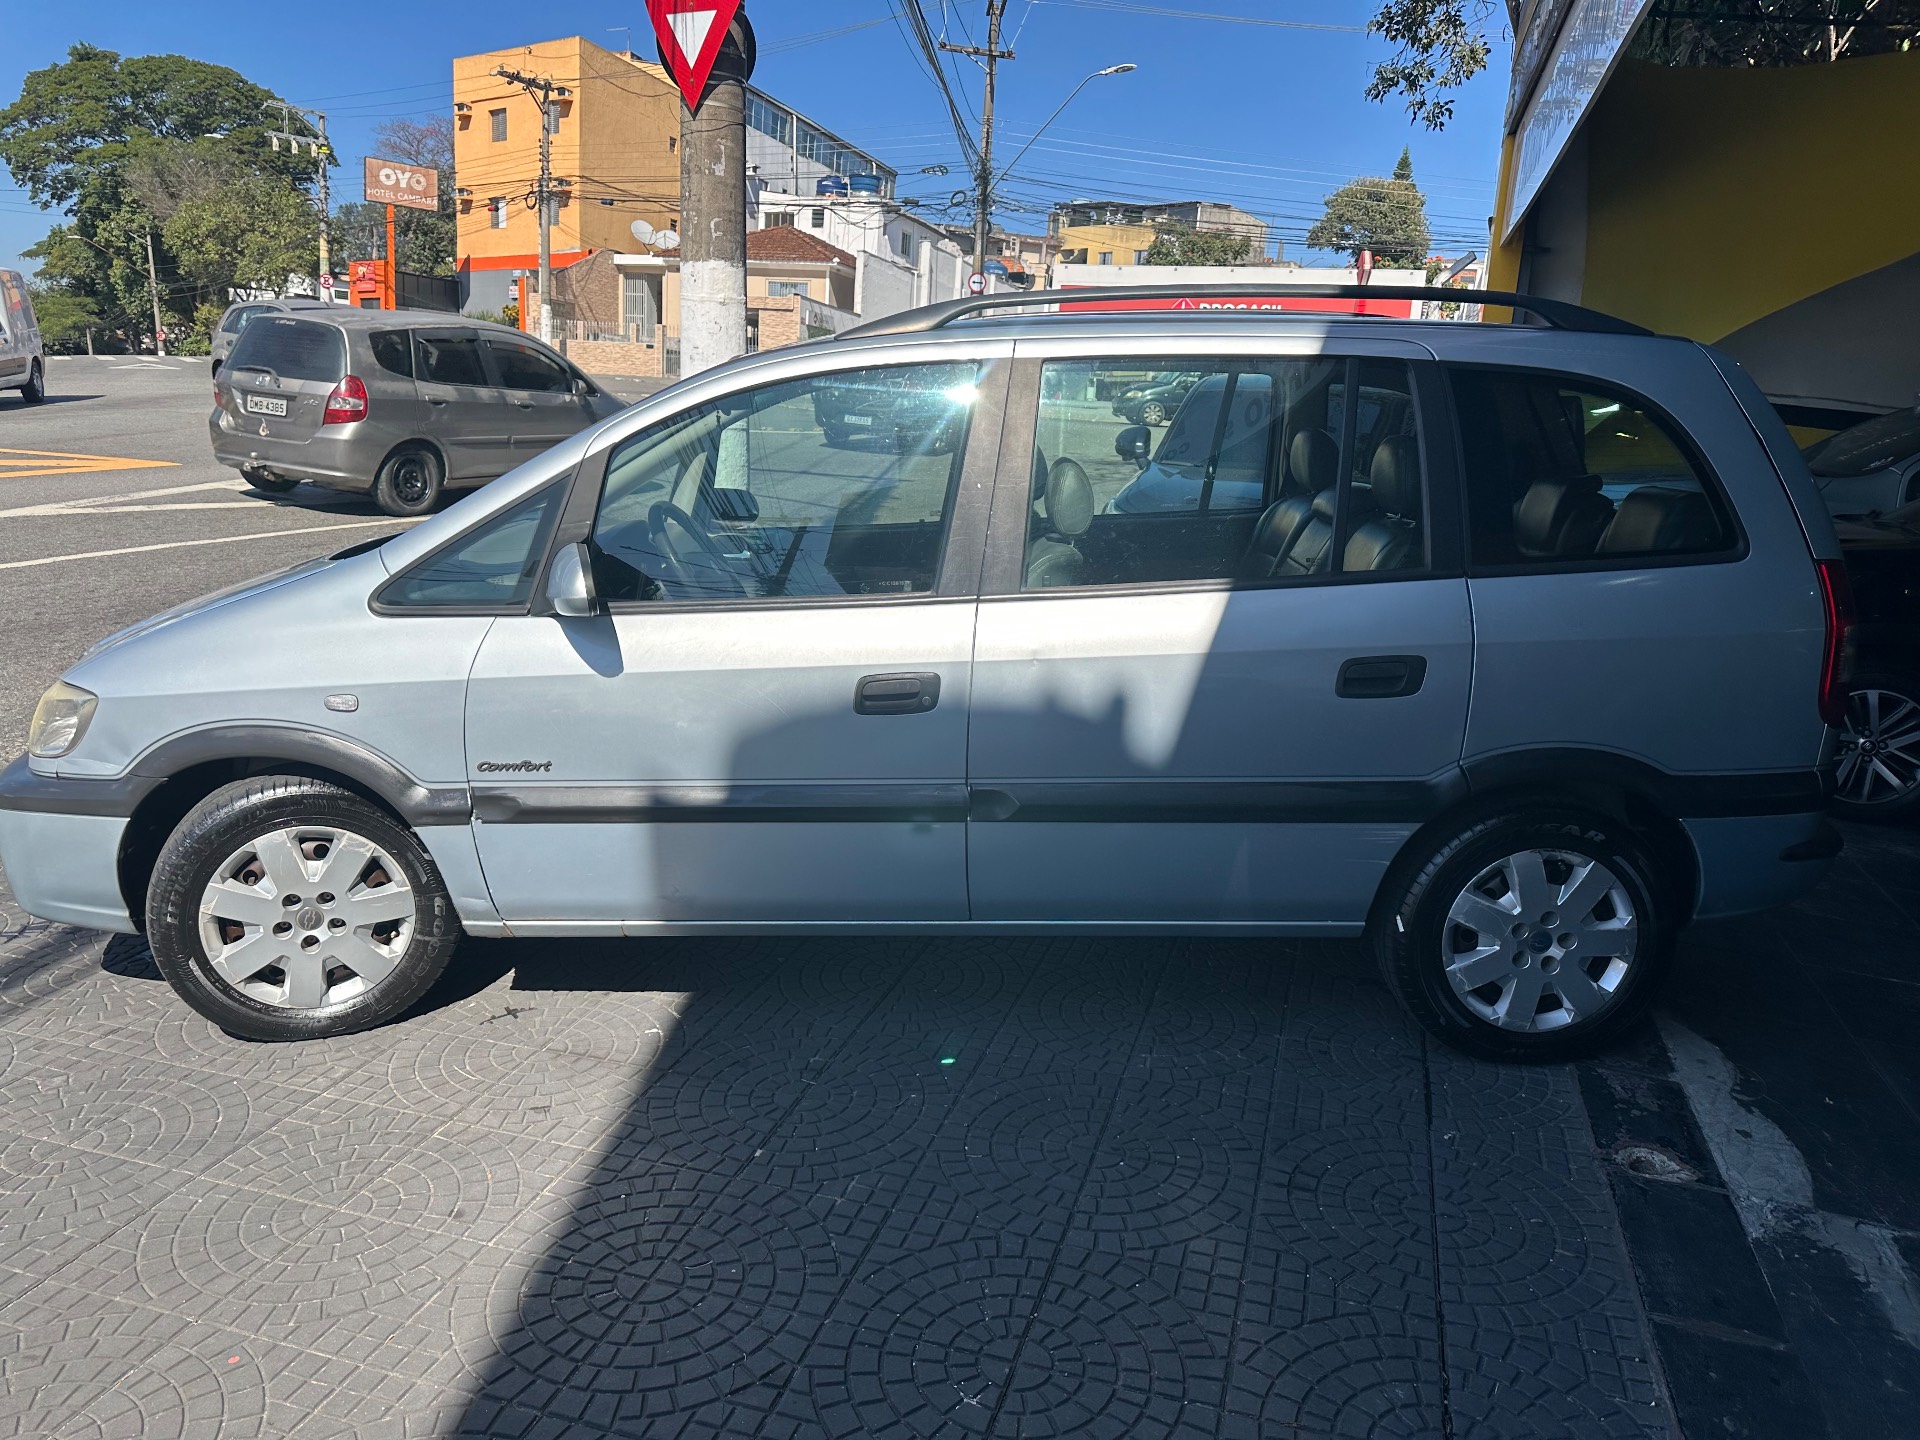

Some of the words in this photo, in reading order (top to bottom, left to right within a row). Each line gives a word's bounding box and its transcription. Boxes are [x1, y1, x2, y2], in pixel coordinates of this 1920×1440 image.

[379, 167, 427, 191] OYO
[367, 187, 396, 199] HOTEL
[476, 759, 553, 773] Comfort
